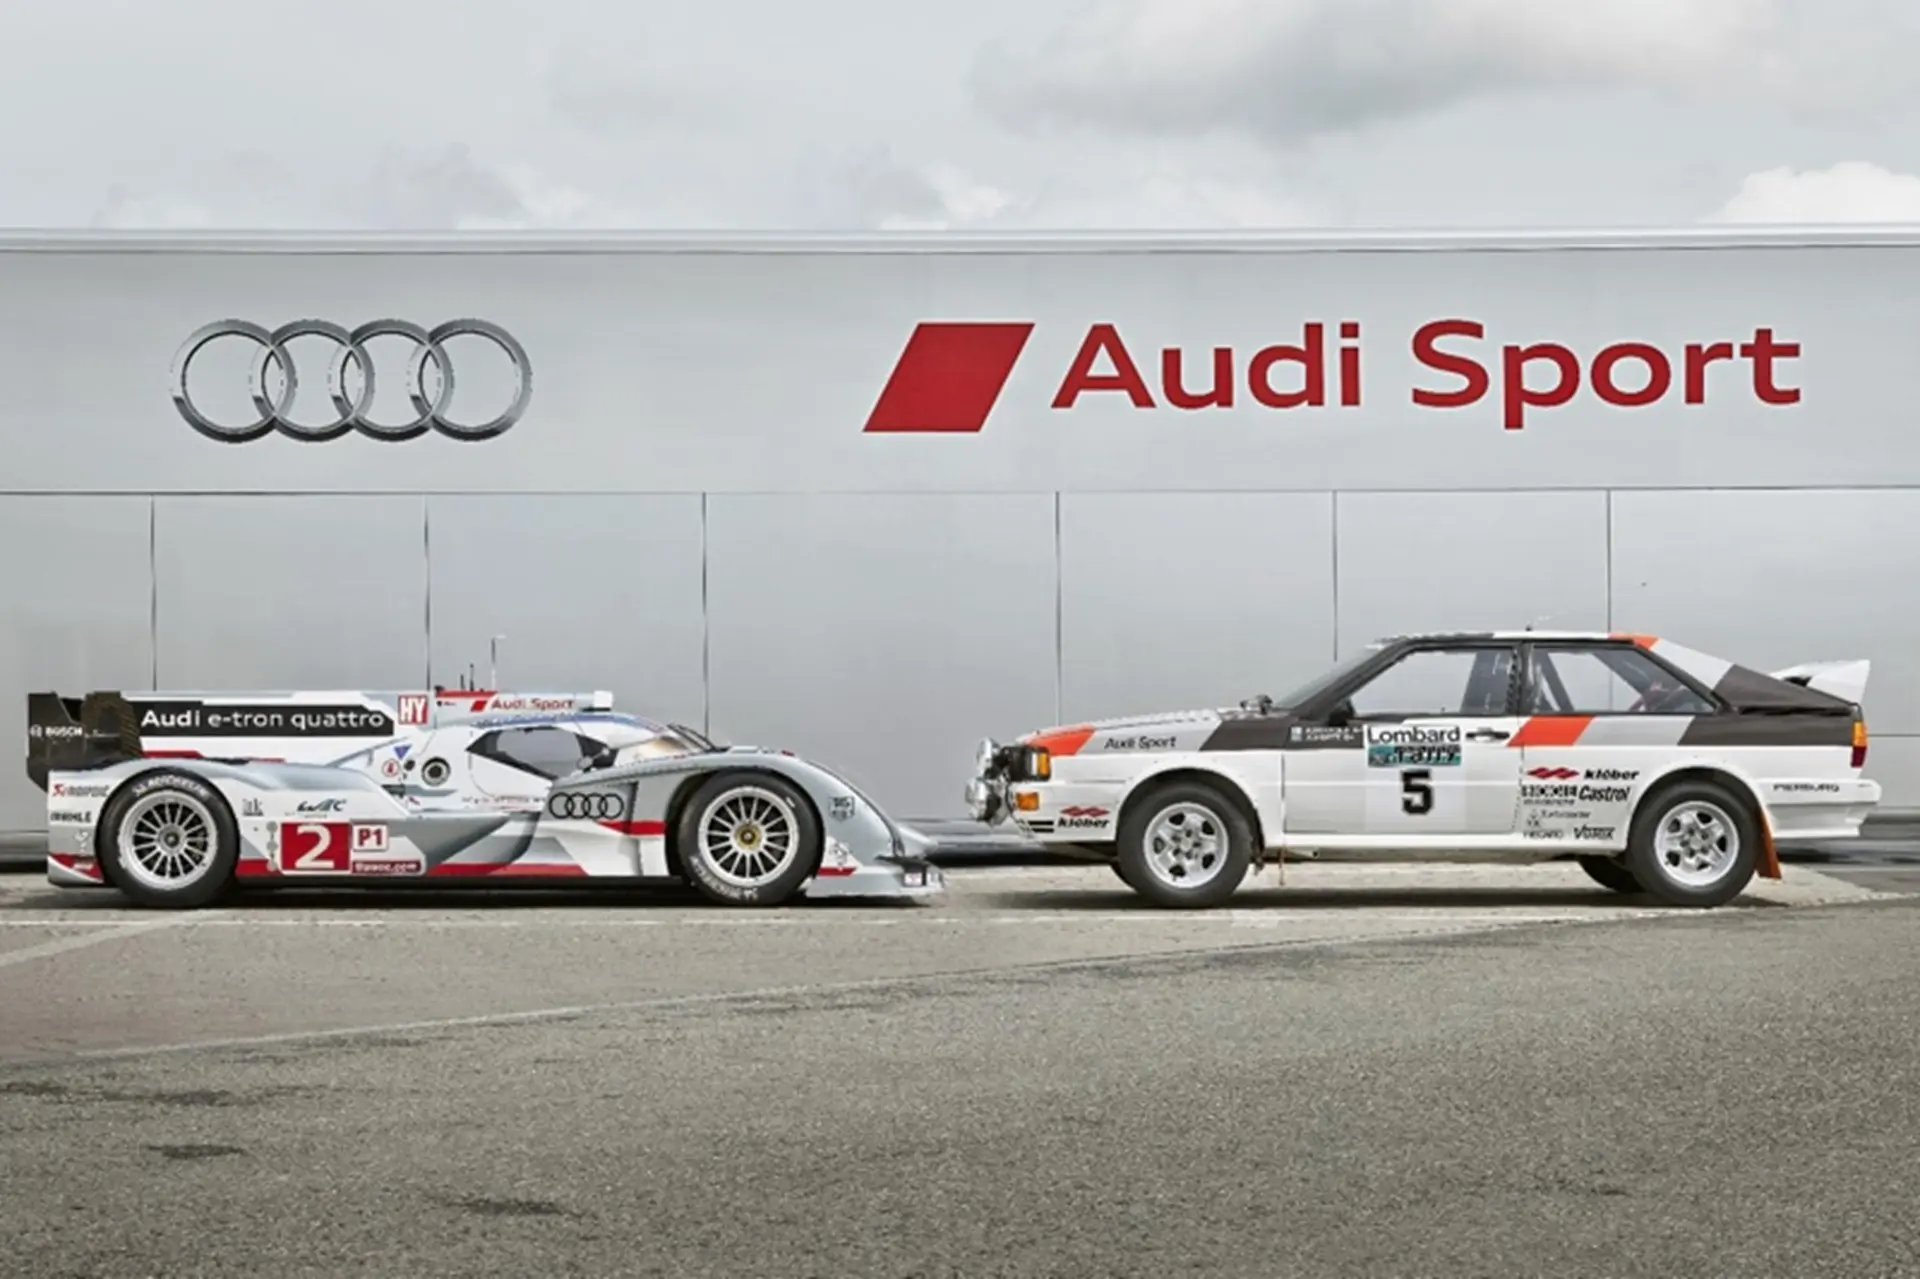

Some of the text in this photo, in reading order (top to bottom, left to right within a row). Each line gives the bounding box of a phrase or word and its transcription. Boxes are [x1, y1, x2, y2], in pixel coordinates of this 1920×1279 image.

[1051, 319, 1802, 430] Audi Sport
[400, 697, 427, 723] HY
[491, 698, 576, 711] Audi Sport
[141, 709, 385, 731] Audi e-tron quattro
[1139, 735, 1177, 751] Sport
[1367, 725, 1461, 744] Lombard
[1401, 769, 1435, 815] 5
[1579, 784, 1631, 802] Castrol
[294, 824, 335, 869] 2
[358, 828, 382, 847] P1
